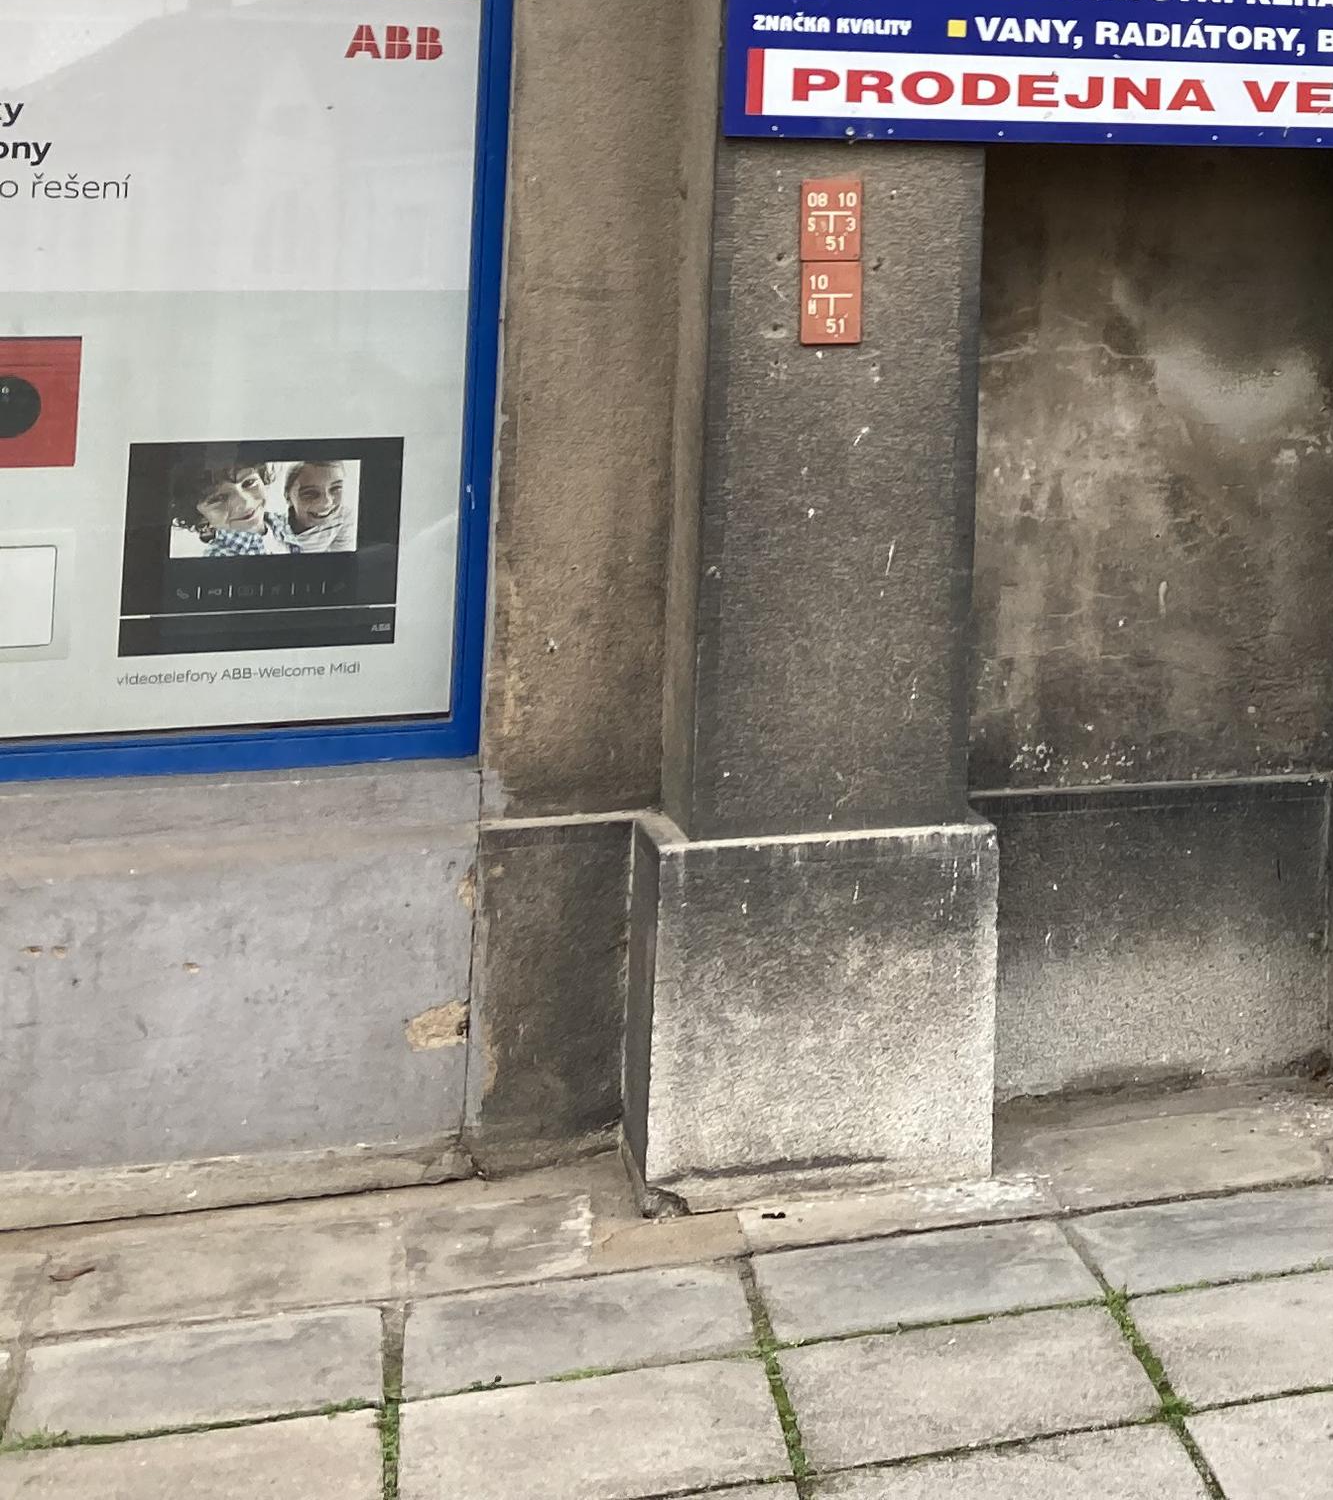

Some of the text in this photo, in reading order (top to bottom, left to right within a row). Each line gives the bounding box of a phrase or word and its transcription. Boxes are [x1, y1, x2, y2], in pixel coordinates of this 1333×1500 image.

[752, 11, 912, 36] ZNAČKA KVALITY
[344, 24, 443, 60] ABB
[974, 17, 1084, 51] VANY,
[1095, 20, 1306, 56] RADIÁTORY,
[791, 67, 1215, 113] PRODEJNA
[31, 172, 132, 199] řešení
[807, 192, 857, 208] 08 10
[845, 217, 856, 232] 3
[825, 236, 845, 251] 51
[809, 275, 829, 290] 10
[826, 318, 846, 334] 51
[116, 661, 361, 686] videotelefony ABB-Welcome Midi
